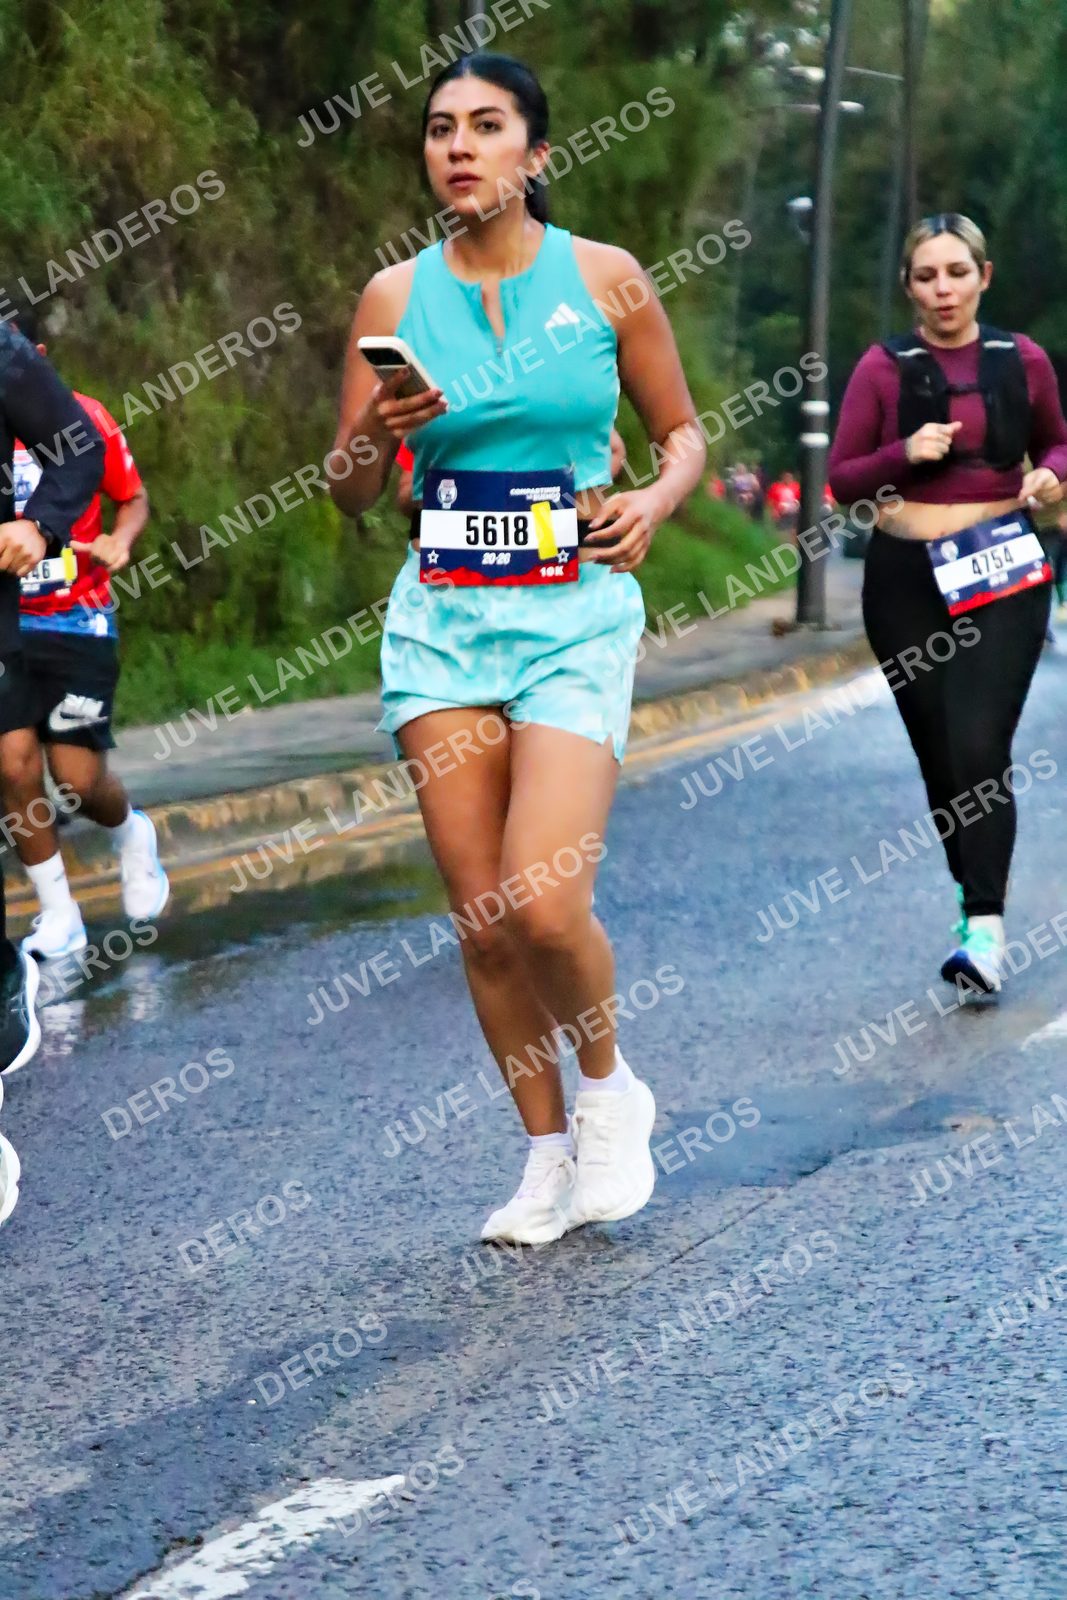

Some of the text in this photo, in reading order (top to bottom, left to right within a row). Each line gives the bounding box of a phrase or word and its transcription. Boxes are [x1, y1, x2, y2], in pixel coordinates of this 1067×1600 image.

[466, 515, 528, 546] 5618
[25, 561, 51, 580] 46
[539, 566, 564, 577] 10K
[971, 546, 1014, 576] 4754
